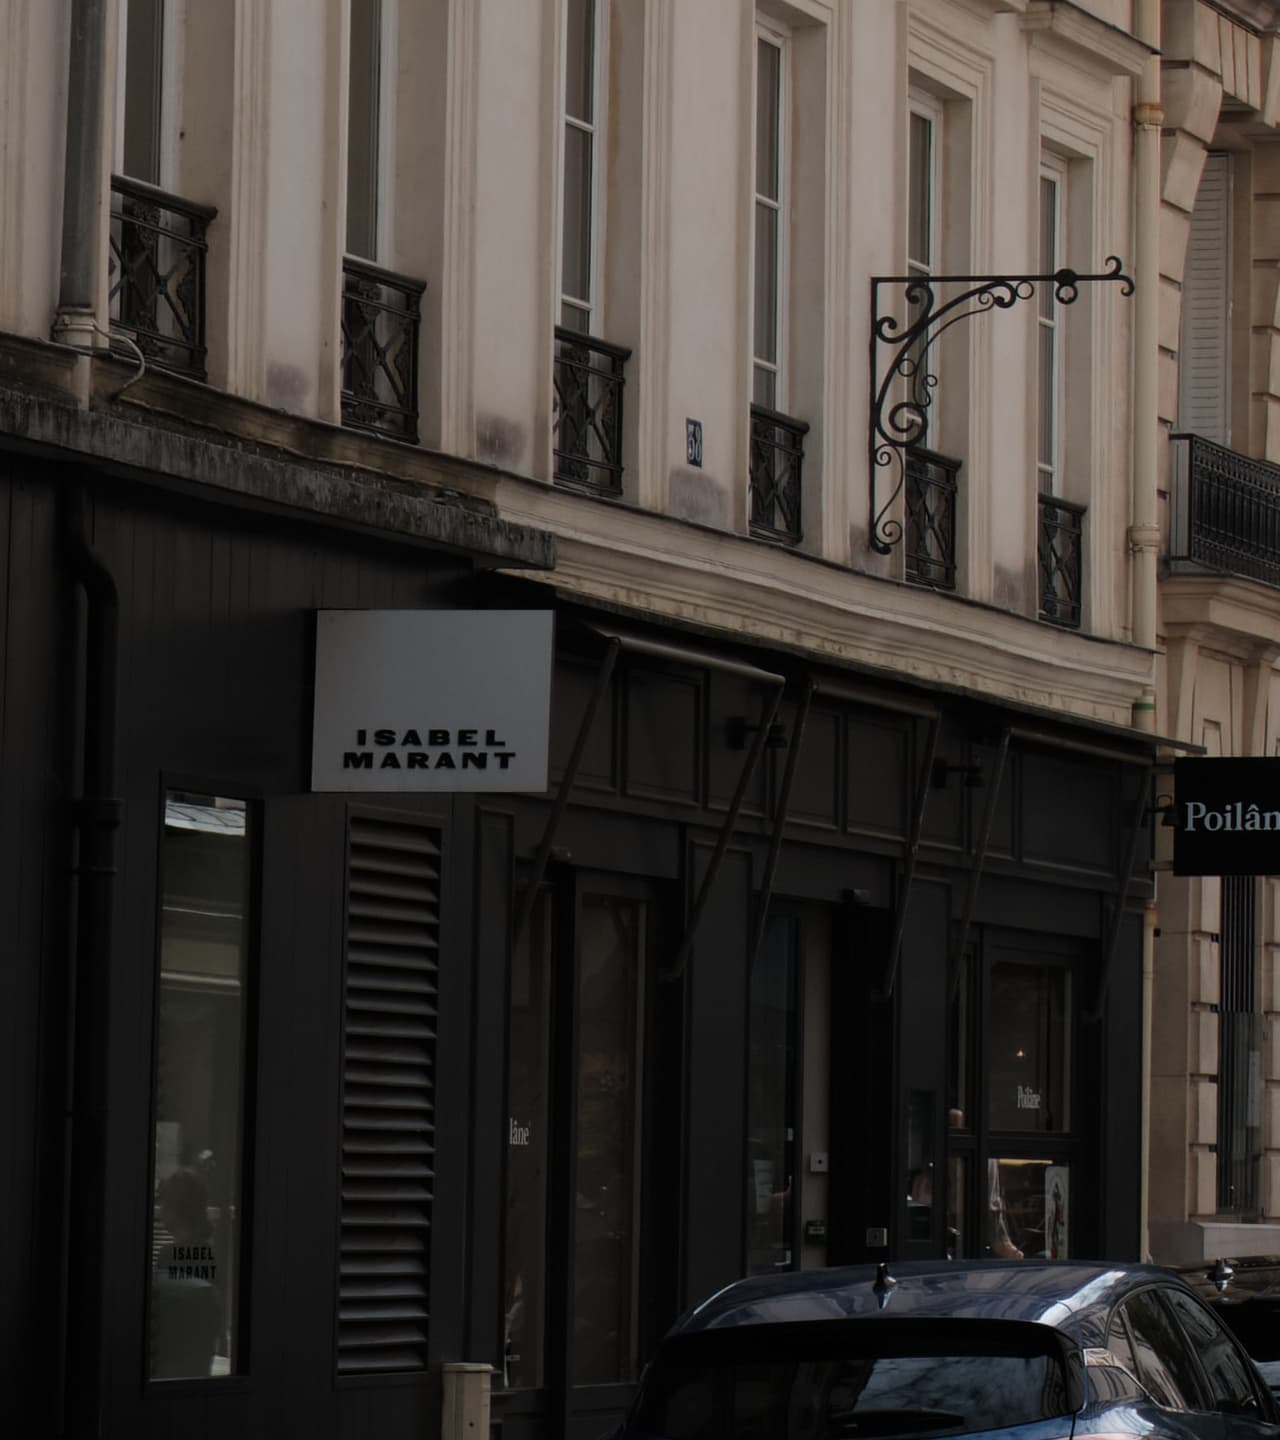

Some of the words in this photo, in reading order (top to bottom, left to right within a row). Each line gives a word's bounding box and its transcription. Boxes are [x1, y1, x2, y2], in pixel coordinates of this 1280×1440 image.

[356, 729, 507, 748] ISABEL
[343, 752, 517, 770] MARANT
[173, 1247, 215, 1261] ISABEL
[168, 1265, 216, 1280] MARANT
